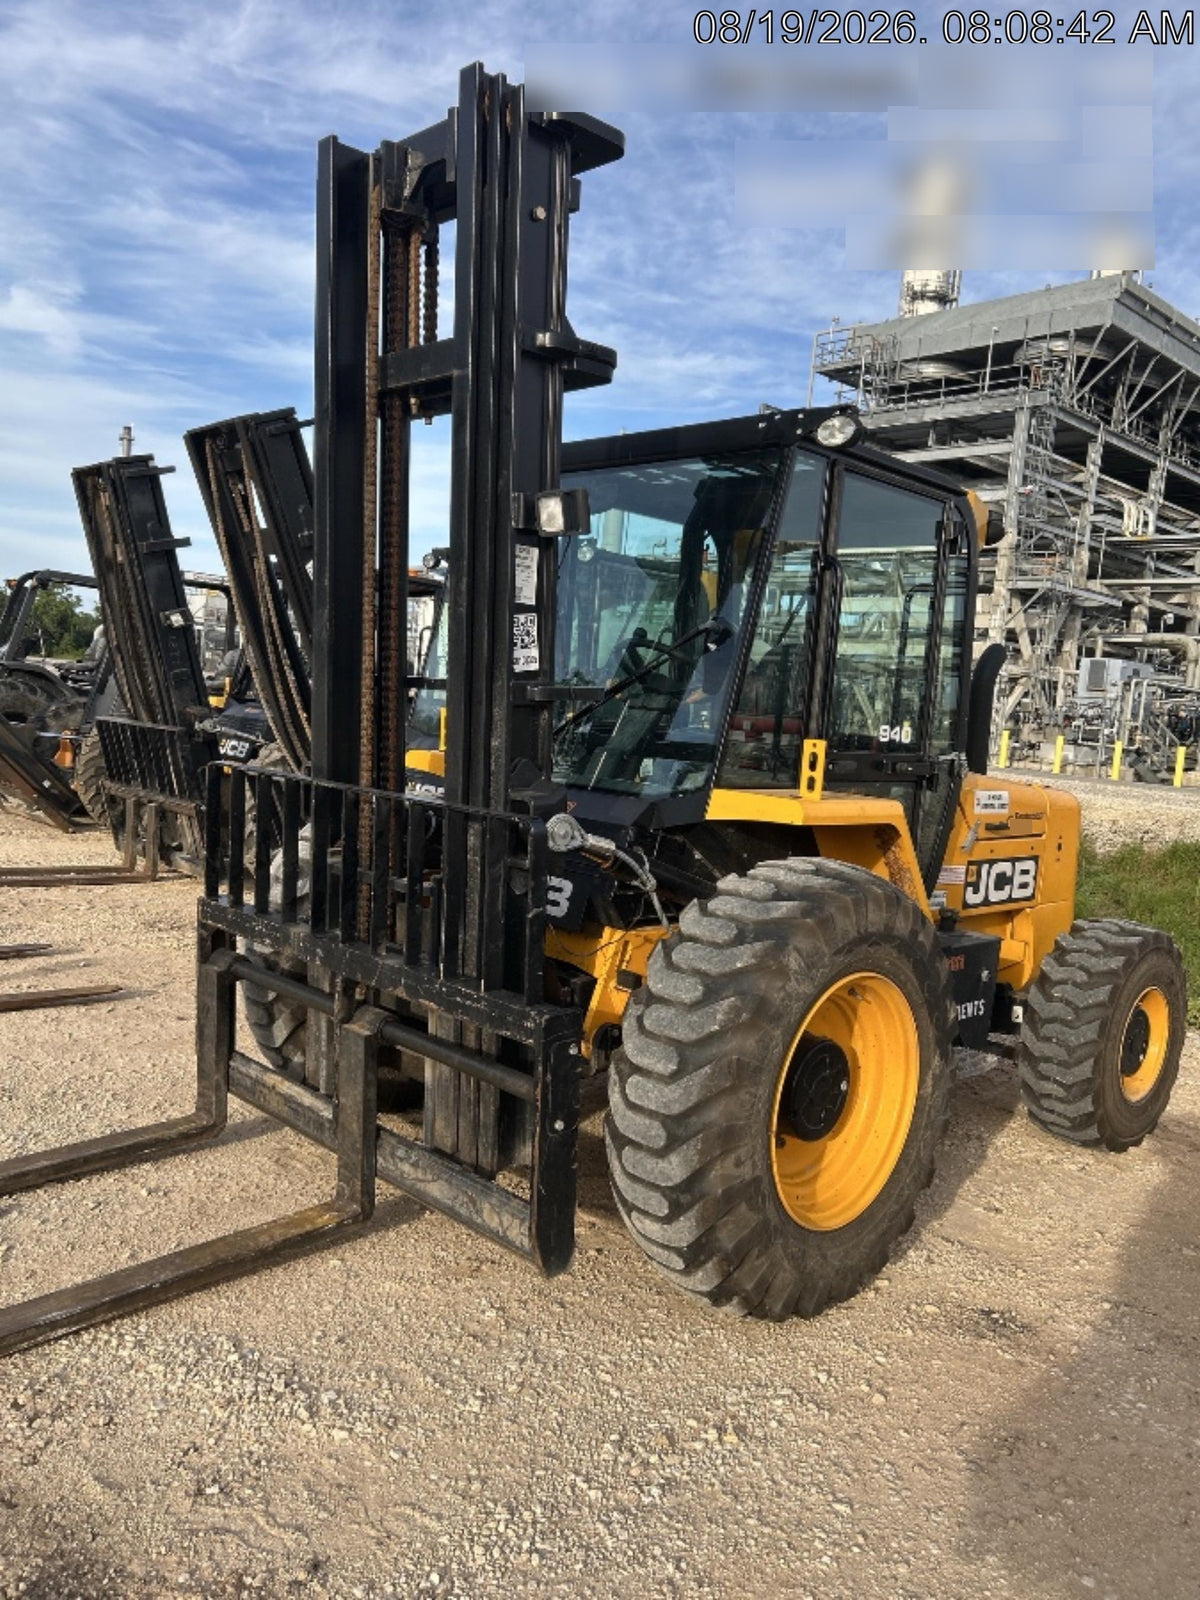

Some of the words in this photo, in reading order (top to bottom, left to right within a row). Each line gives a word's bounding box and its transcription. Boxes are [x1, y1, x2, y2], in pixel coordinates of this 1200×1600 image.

[879, 725, 912, 744] 940
[218, 739, 249, 758] JCB
[965, 859, 1037, 905] JCB
